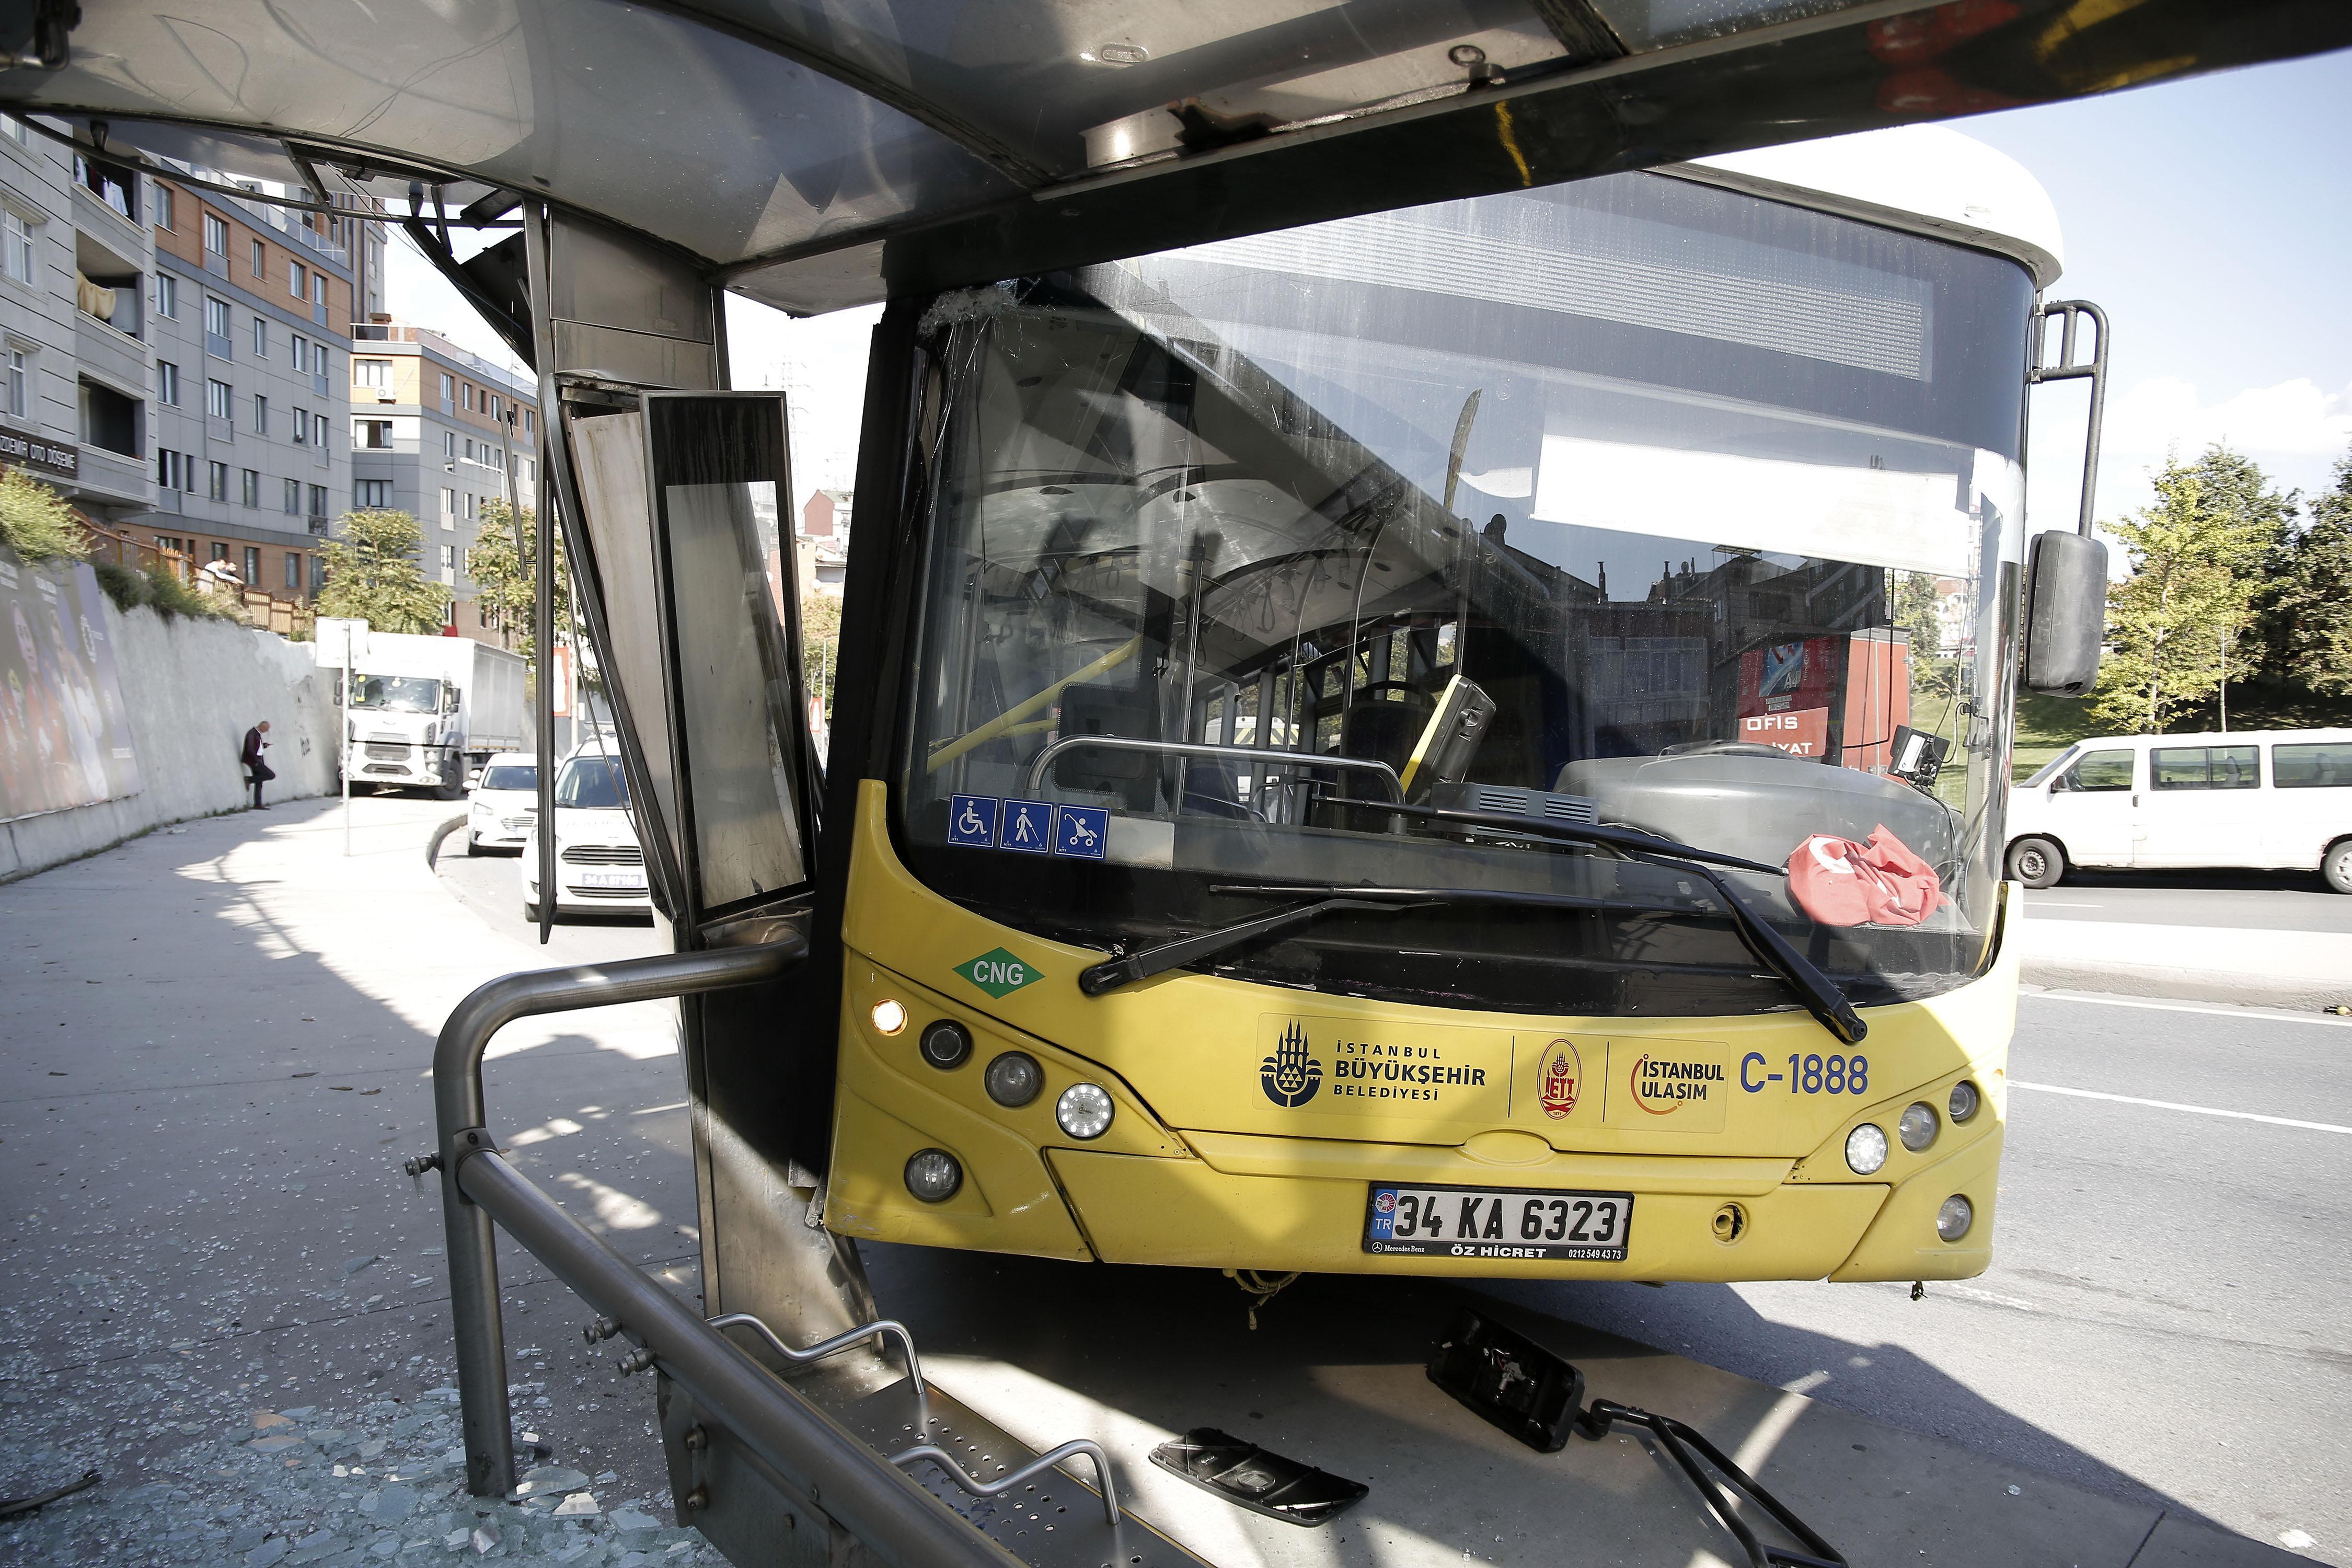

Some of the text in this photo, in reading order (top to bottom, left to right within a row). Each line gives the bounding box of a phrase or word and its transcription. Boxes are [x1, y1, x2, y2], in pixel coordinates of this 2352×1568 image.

[30, 444, 46, 461] OTO
[974, 961, 1023, 985] CNG
[1336, 1040, 1440, 1059] İSTANBUL
[1335, 1057, 1486, 1086] BÜYÜKŞEHİR
[1642, 1054, 1725, 1081] İSTANBUL
[1741, 1052, 1868, 1095] C-1888
[1334, 1084, 1438, 1101] BELEDİYESİ
[1375, 1218, 1391, 1230] TR
[1395, 1195, 1617, 1241] 34 KA 6323
[1451, 1243, 1547, 1258] ÖZ HİCRET
[1569, 1249, 1621, 1260] 0212 549 43 73
